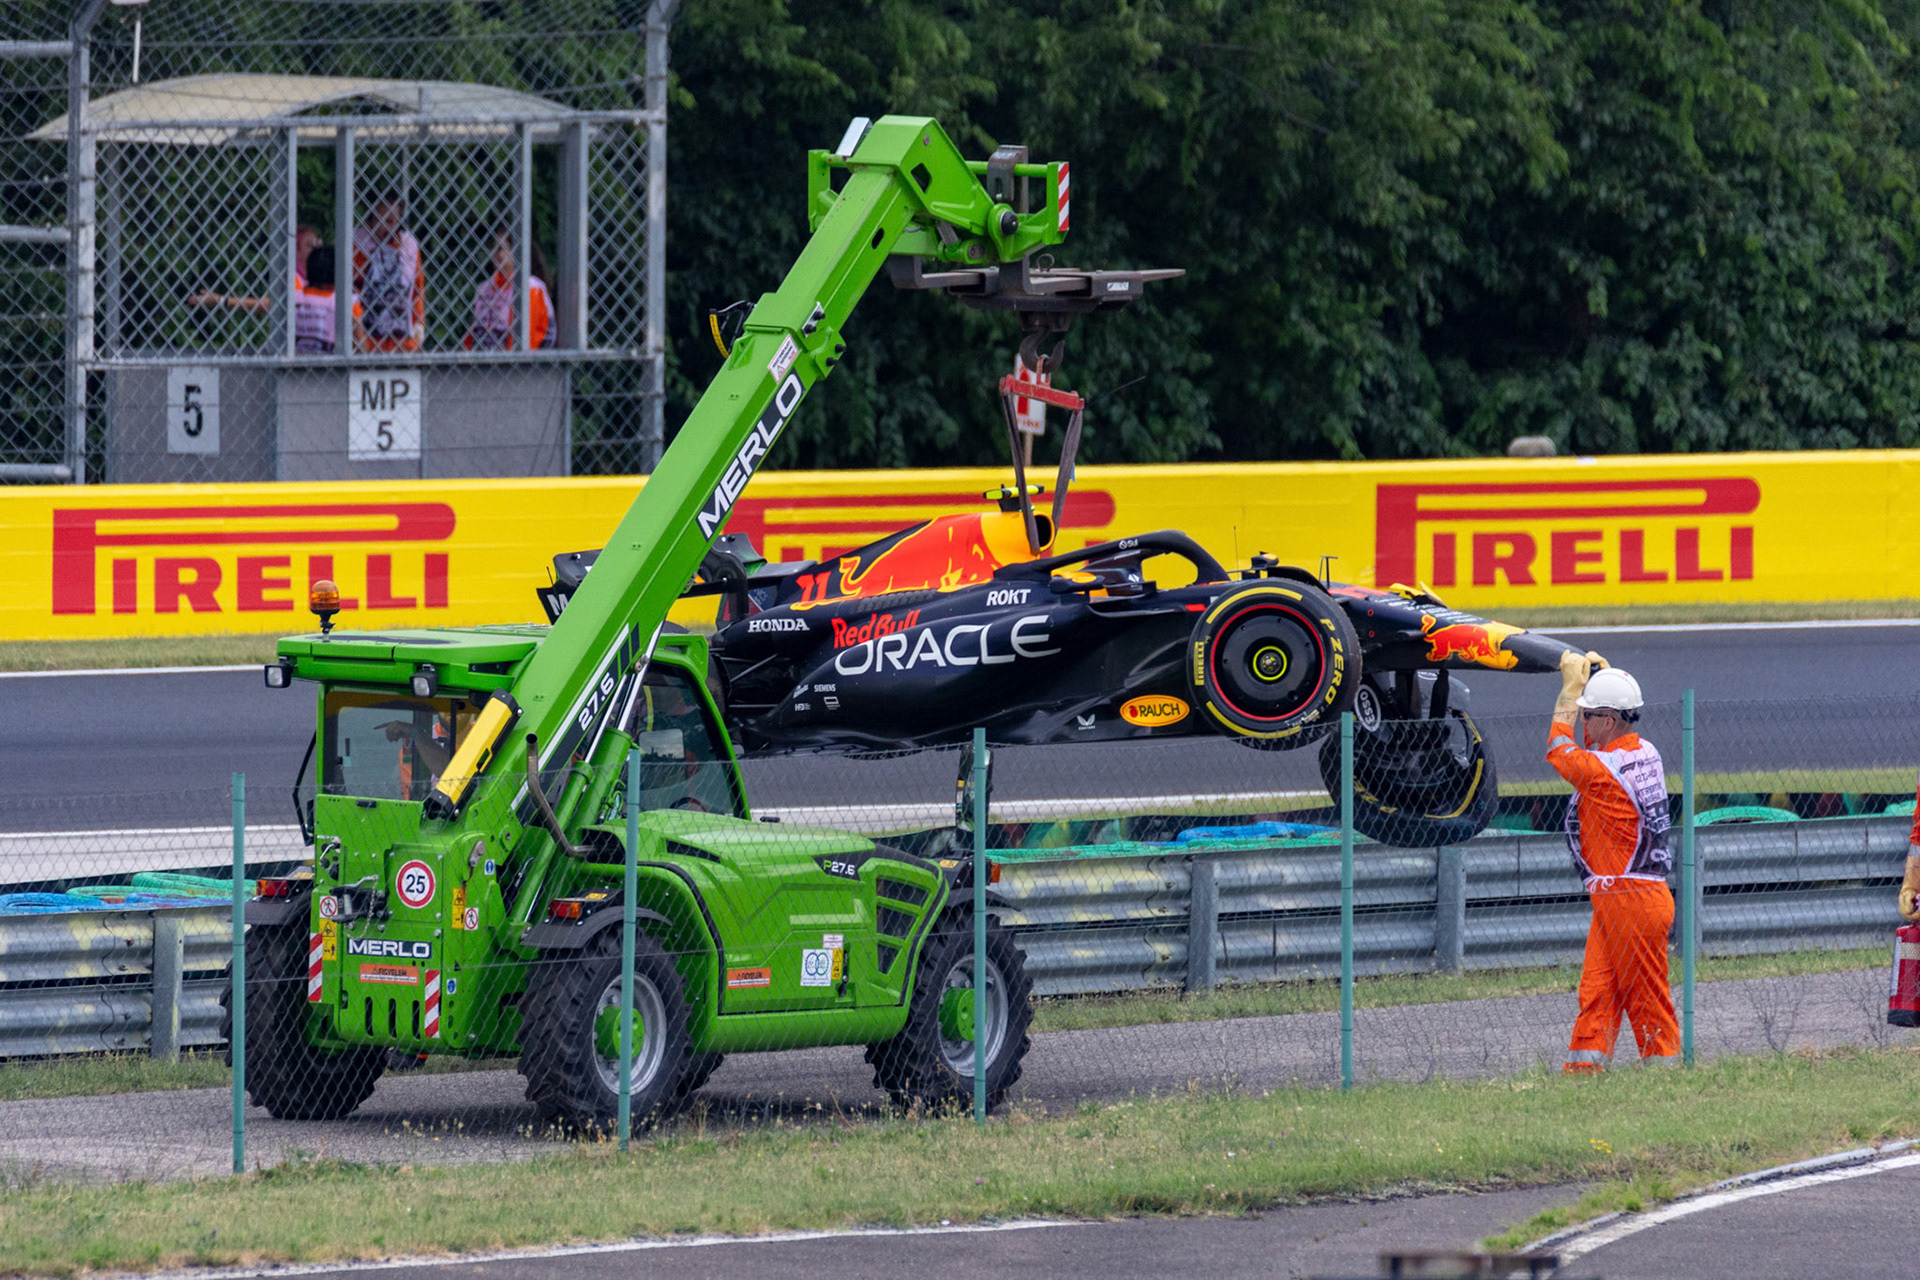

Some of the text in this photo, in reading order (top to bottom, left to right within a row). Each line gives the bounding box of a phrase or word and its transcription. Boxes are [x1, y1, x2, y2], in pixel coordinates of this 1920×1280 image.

[183, 384, 204, 437] 5
[361, 379, 409, 411] MP
[377, 421, 394, 452] 5
[697, 373, 802, 539] MERLO
[1375, 475, 1762, 588] PIRELLI
[53, 502, 456, 615] PIRELLI
[796, 571, 832, 602] 11
[986, 588, 1031, 607] ROKT
[748, 618, 810, 633] HONDA
[835, 615, 1062, 676] ORACLE
[1320, 618, 1344, 705] P ZERO
[578, 672, 614, 731] 27.6
[1140, 703, 1181, 717] RAUCH
[823, 860, 856, 876] P27.6
[405, 874, 426, 894] 25
[348, 938, 430, 958] MERLO
